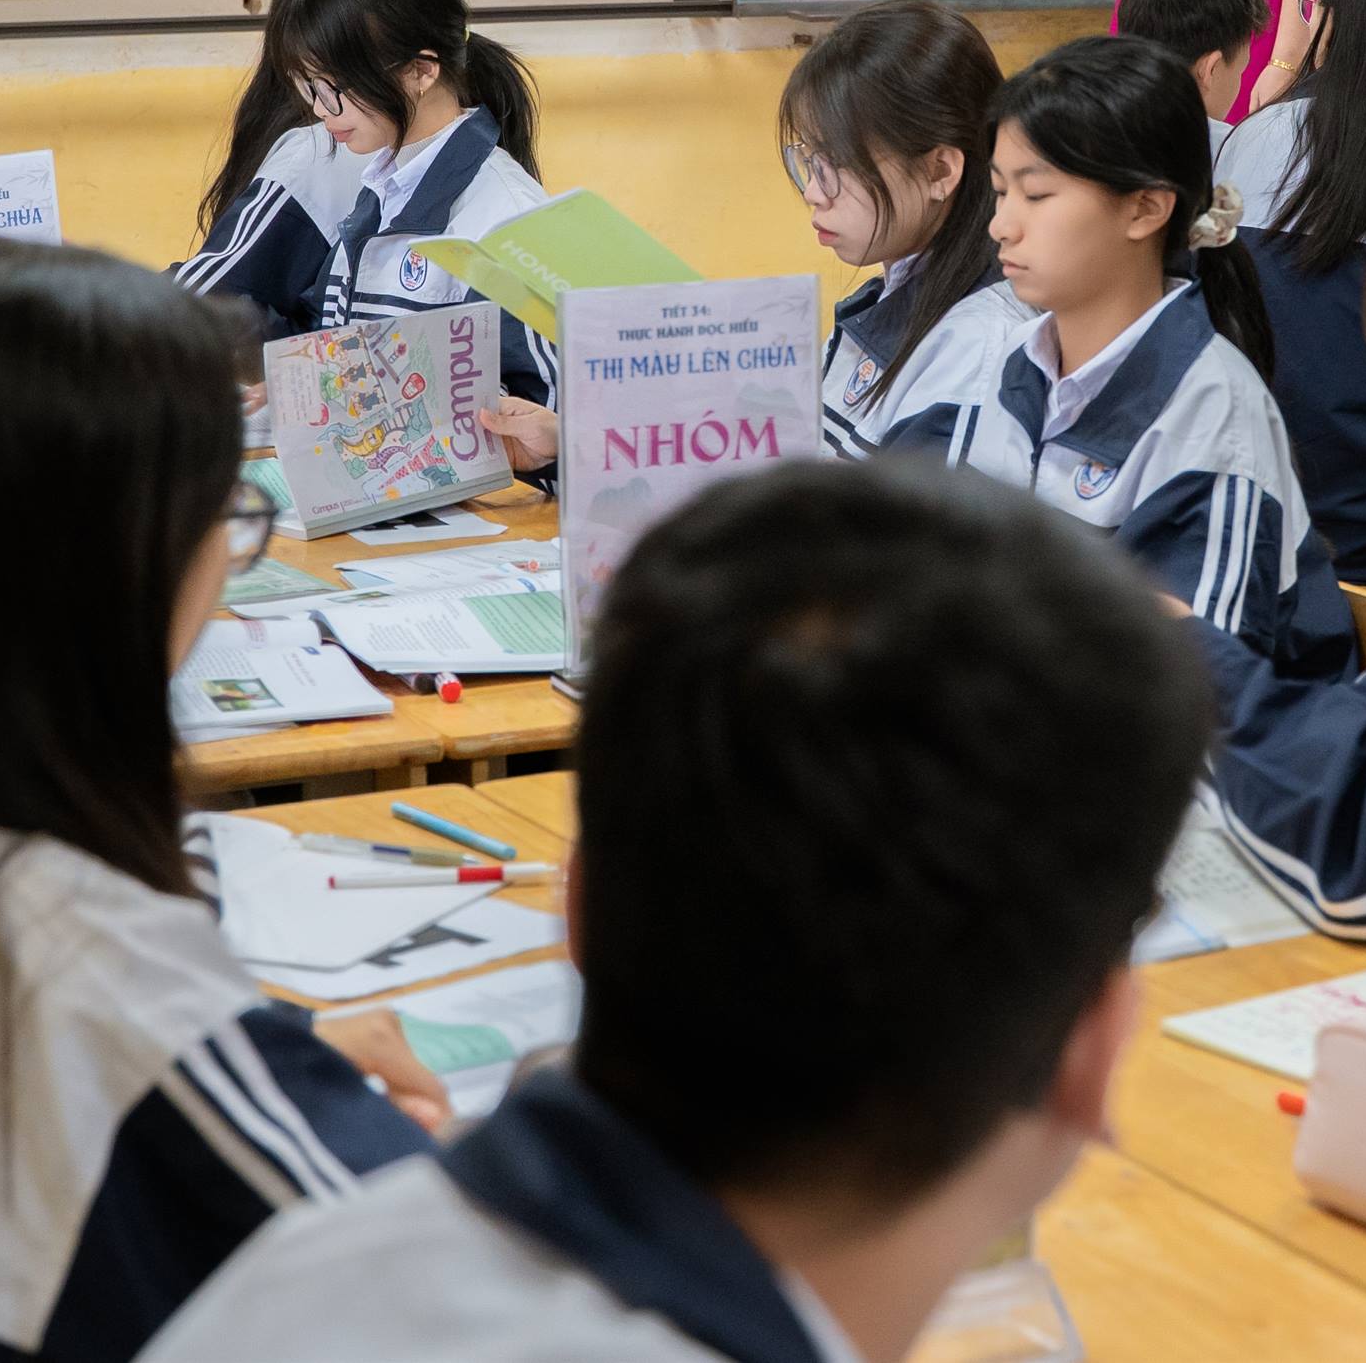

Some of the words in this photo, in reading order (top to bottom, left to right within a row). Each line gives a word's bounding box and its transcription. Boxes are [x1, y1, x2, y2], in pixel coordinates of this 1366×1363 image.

[450, 316, 483, 462] Campus
[585, 357, 624, 384] THỊ
[737, 342, 798, 370] CHÙA
[603, 409, 782, 471] NHÓM
